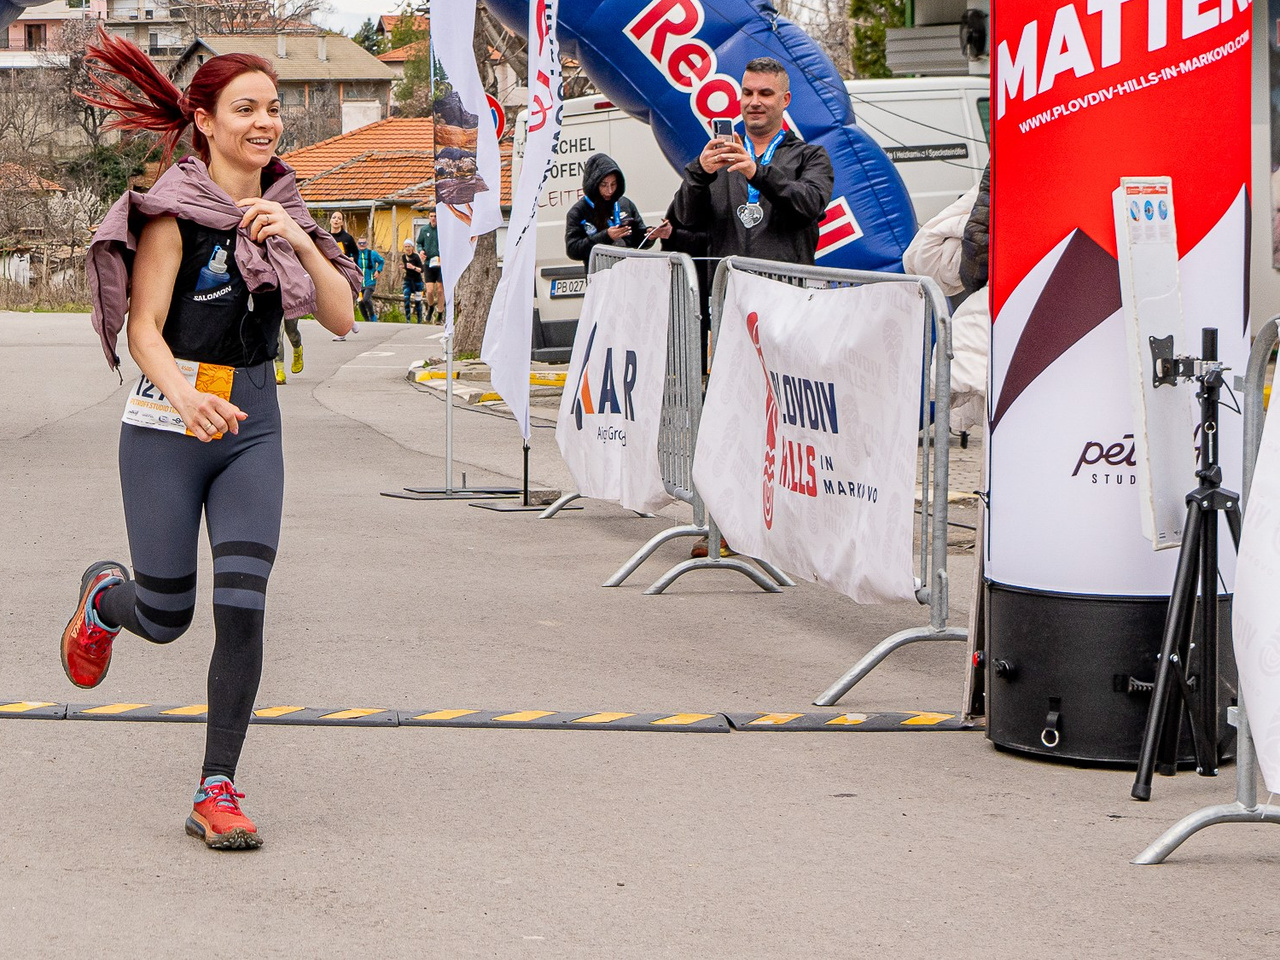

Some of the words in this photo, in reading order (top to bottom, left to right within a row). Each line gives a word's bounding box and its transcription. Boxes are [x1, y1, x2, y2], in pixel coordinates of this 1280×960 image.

[1018, 28, 1250, 135] WWW.PLOVDIV-HILLS-IN-MARKOVO.COM
[558, 137, 596, 155] CHEL
[192, 285, 232, 302] SALOMON
[820, 454, 834, 472] IN
